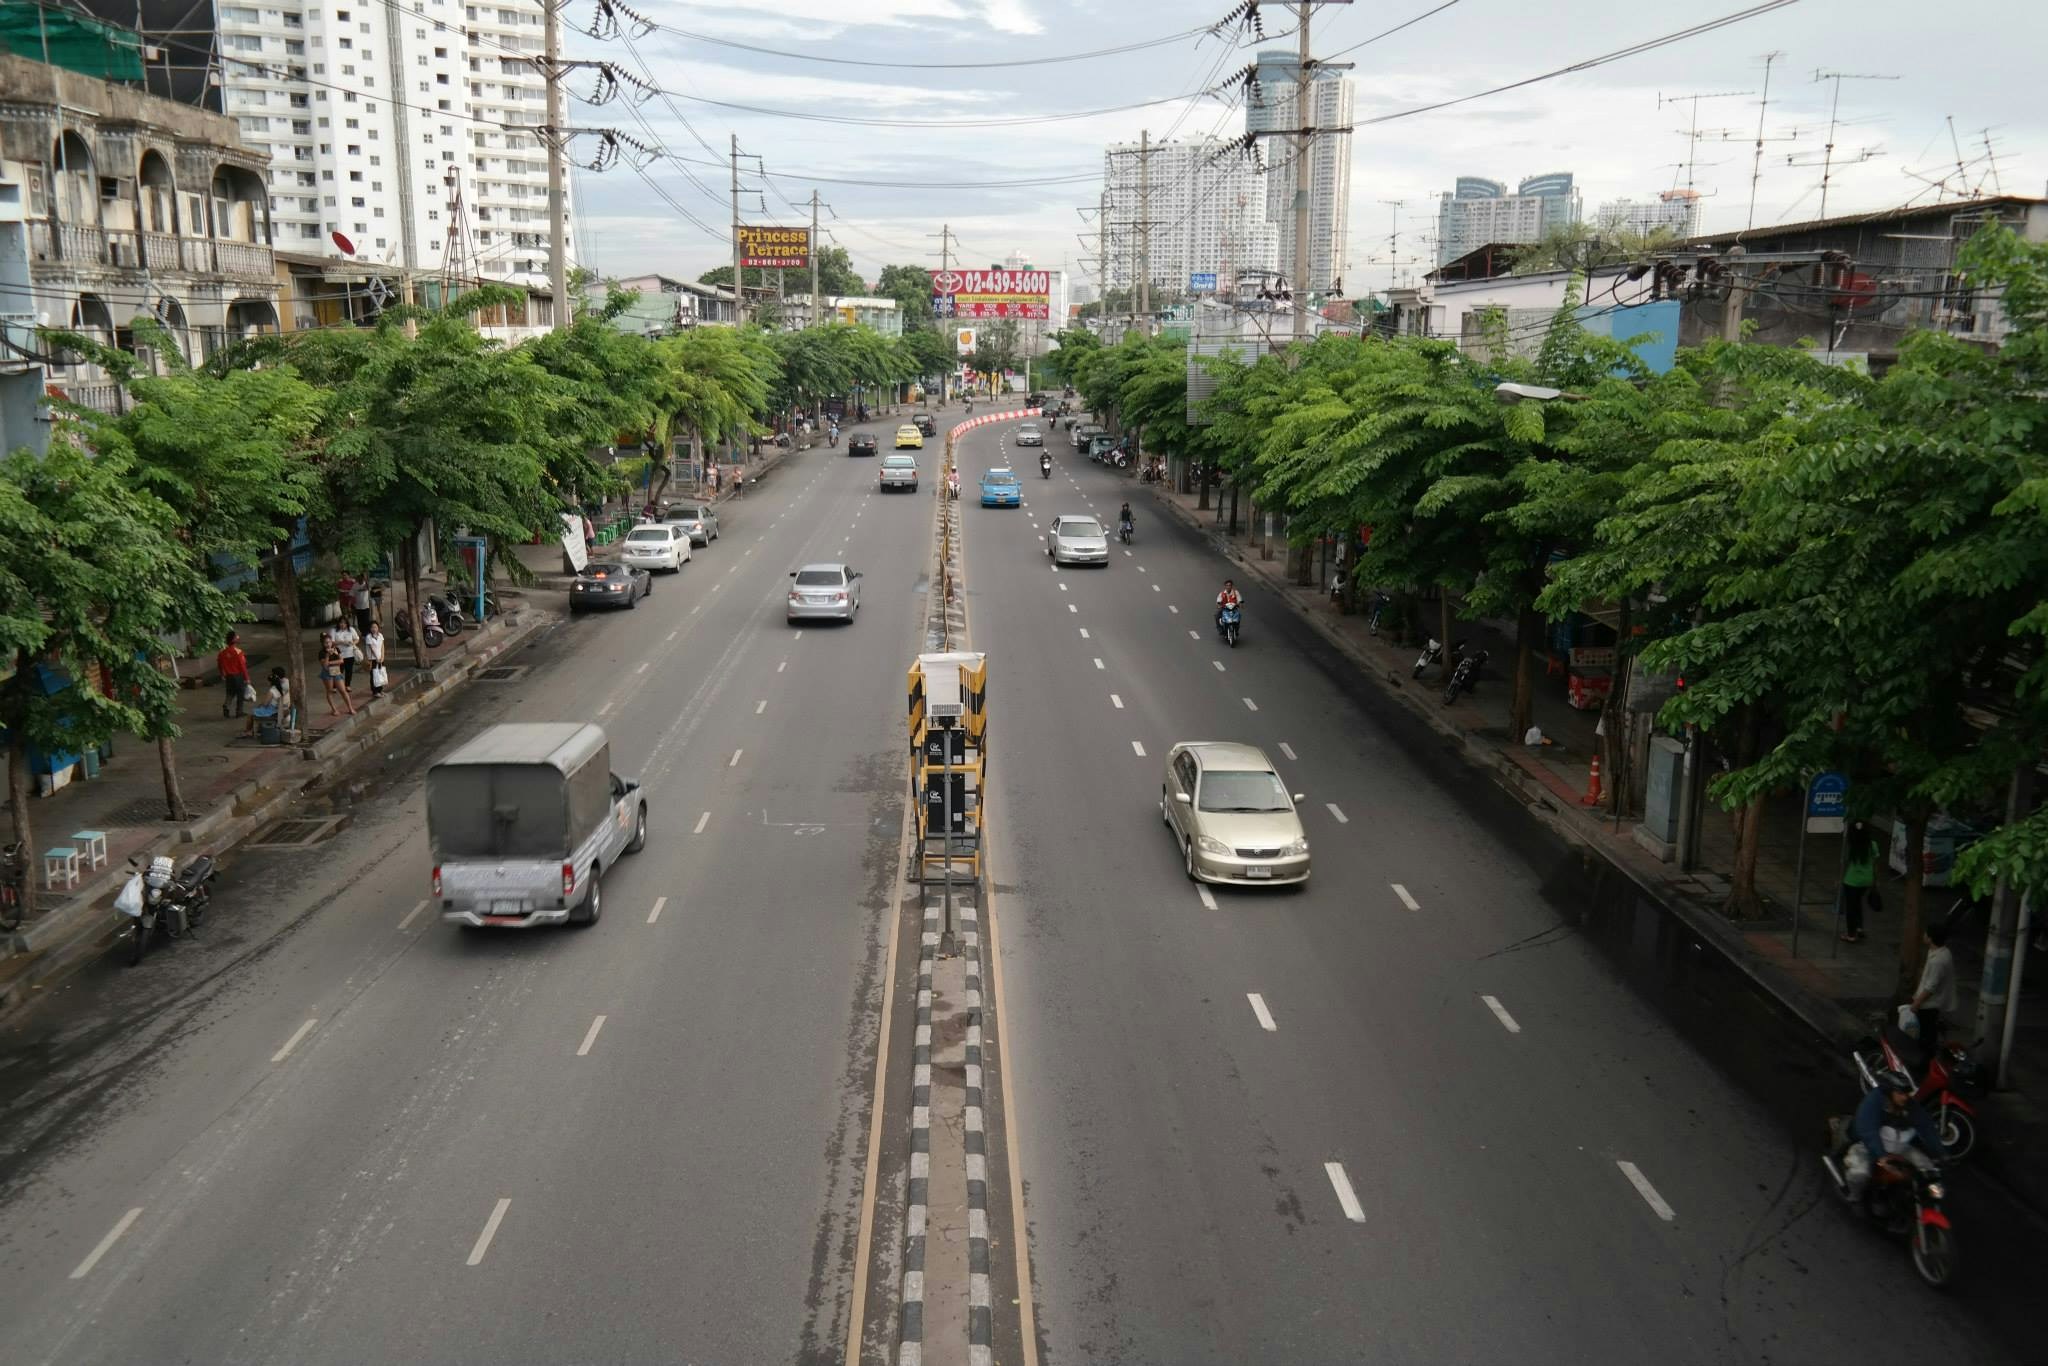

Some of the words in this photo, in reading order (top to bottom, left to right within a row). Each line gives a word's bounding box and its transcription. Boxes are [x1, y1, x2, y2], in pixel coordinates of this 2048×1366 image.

[737, 228, 807, 243] Princess
[746, 243, 808, 257] Terrace
[965, 271, 1047, 293] 02-439-5600
